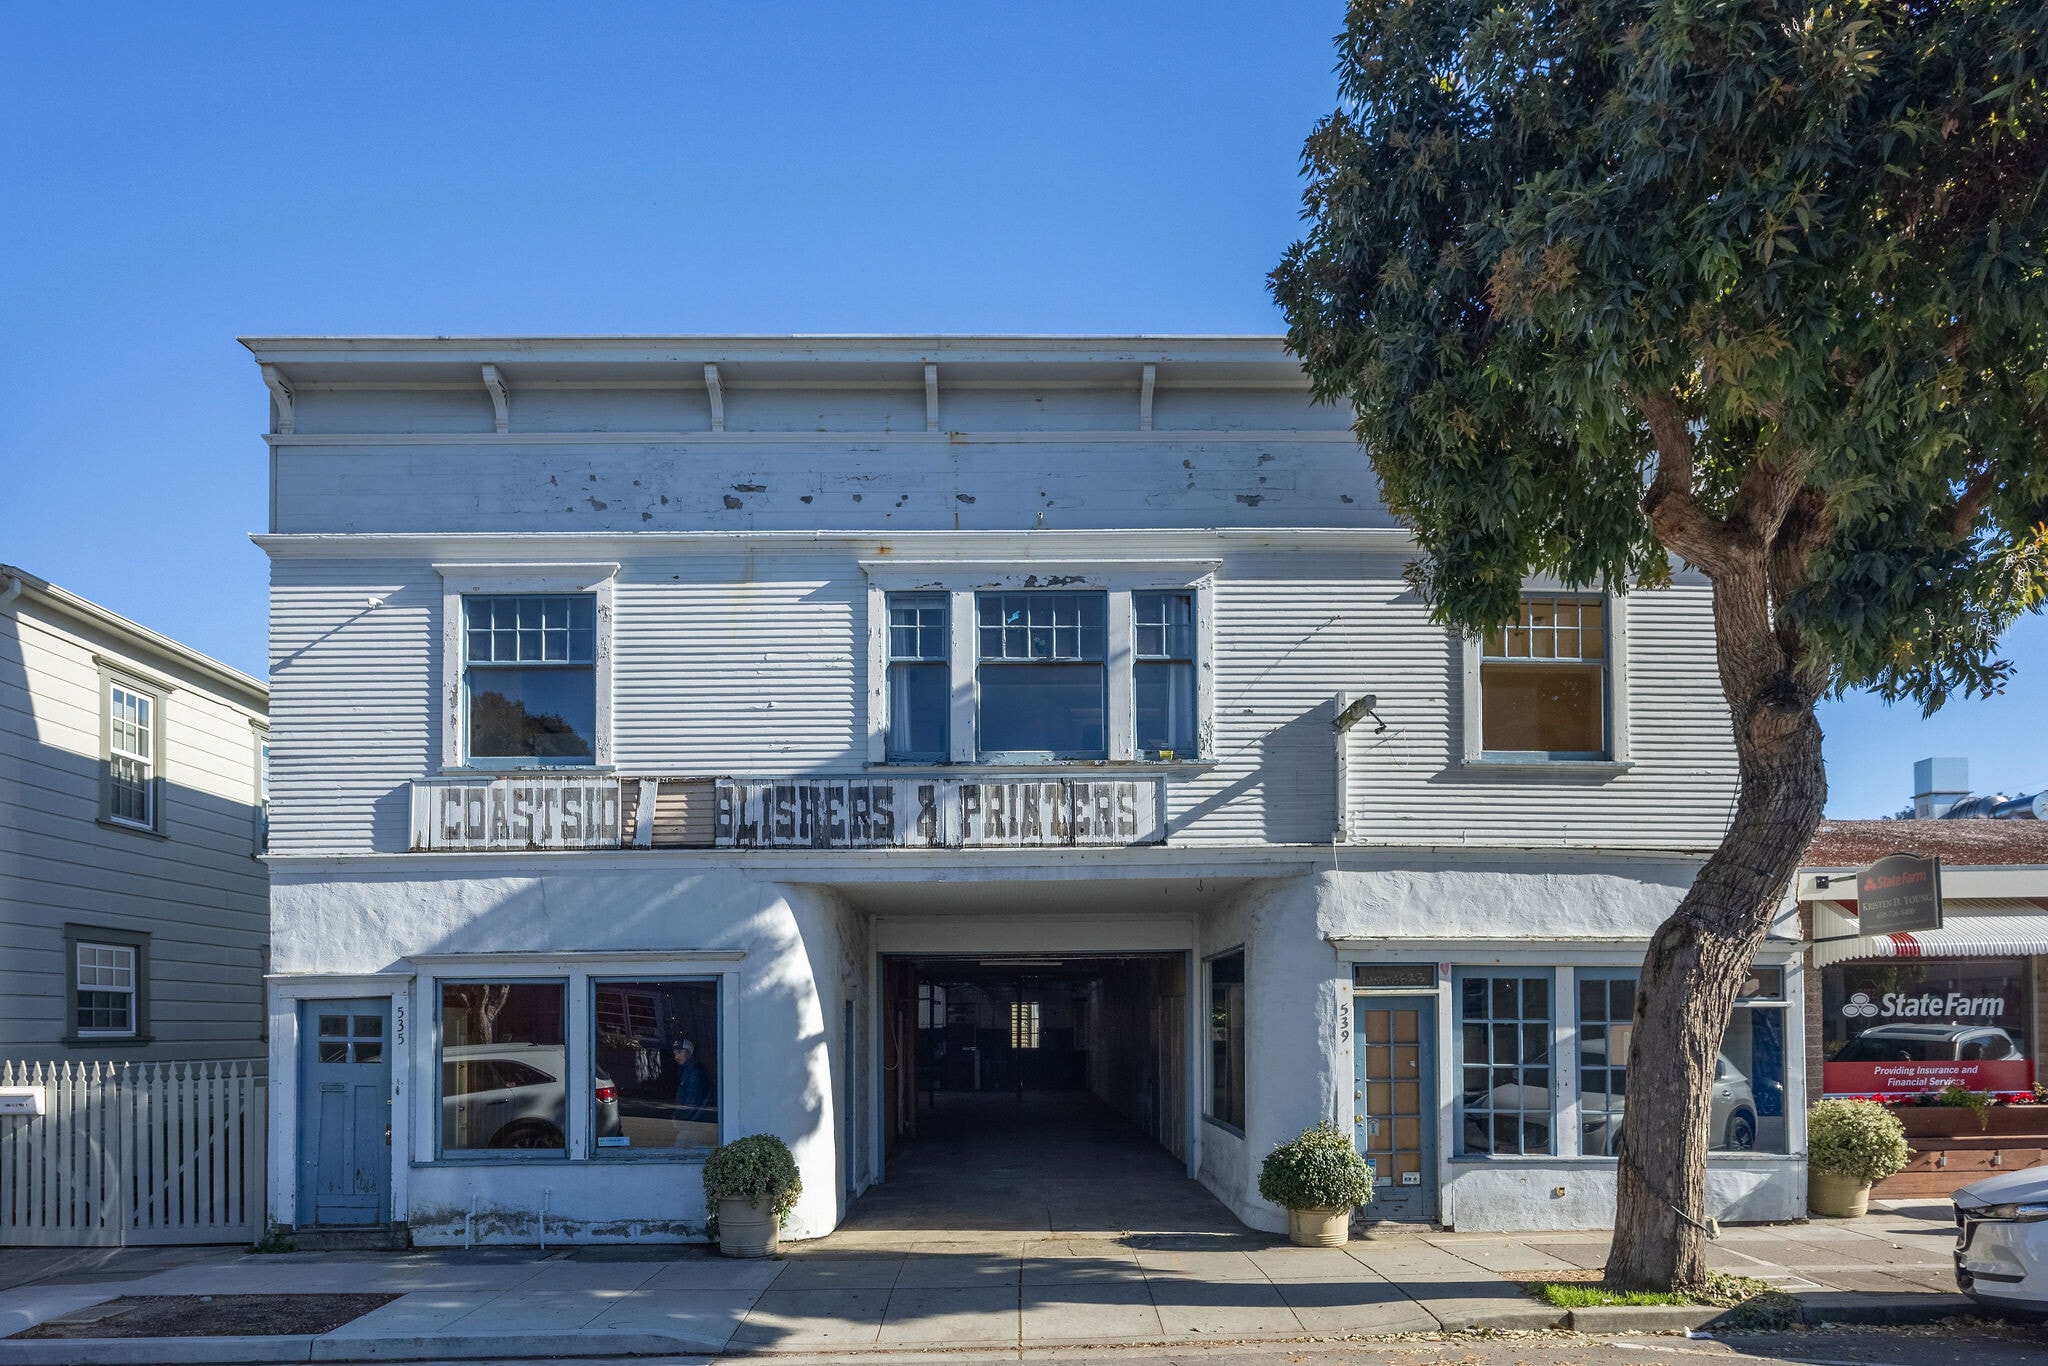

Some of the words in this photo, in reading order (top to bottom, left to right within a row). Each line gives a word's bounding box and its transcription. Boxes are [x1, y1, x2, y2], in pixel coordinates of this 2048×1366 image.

[916, 784, 937, 840] &
[959, 784, 1138, 839] PRINTERS
[1903, 892, 1934, 905] YOUNG
[397, 1006, 405, 1046] 535
[1339, 1002, 1349, 1044] 539
[1874, 1066, 1915, 1076] Providing
[1917, 1066, 1960, 1075] Insurance
[1961, 1065, 1979, 1074] and
[1887, 1077, 1928, 1087] Financial
